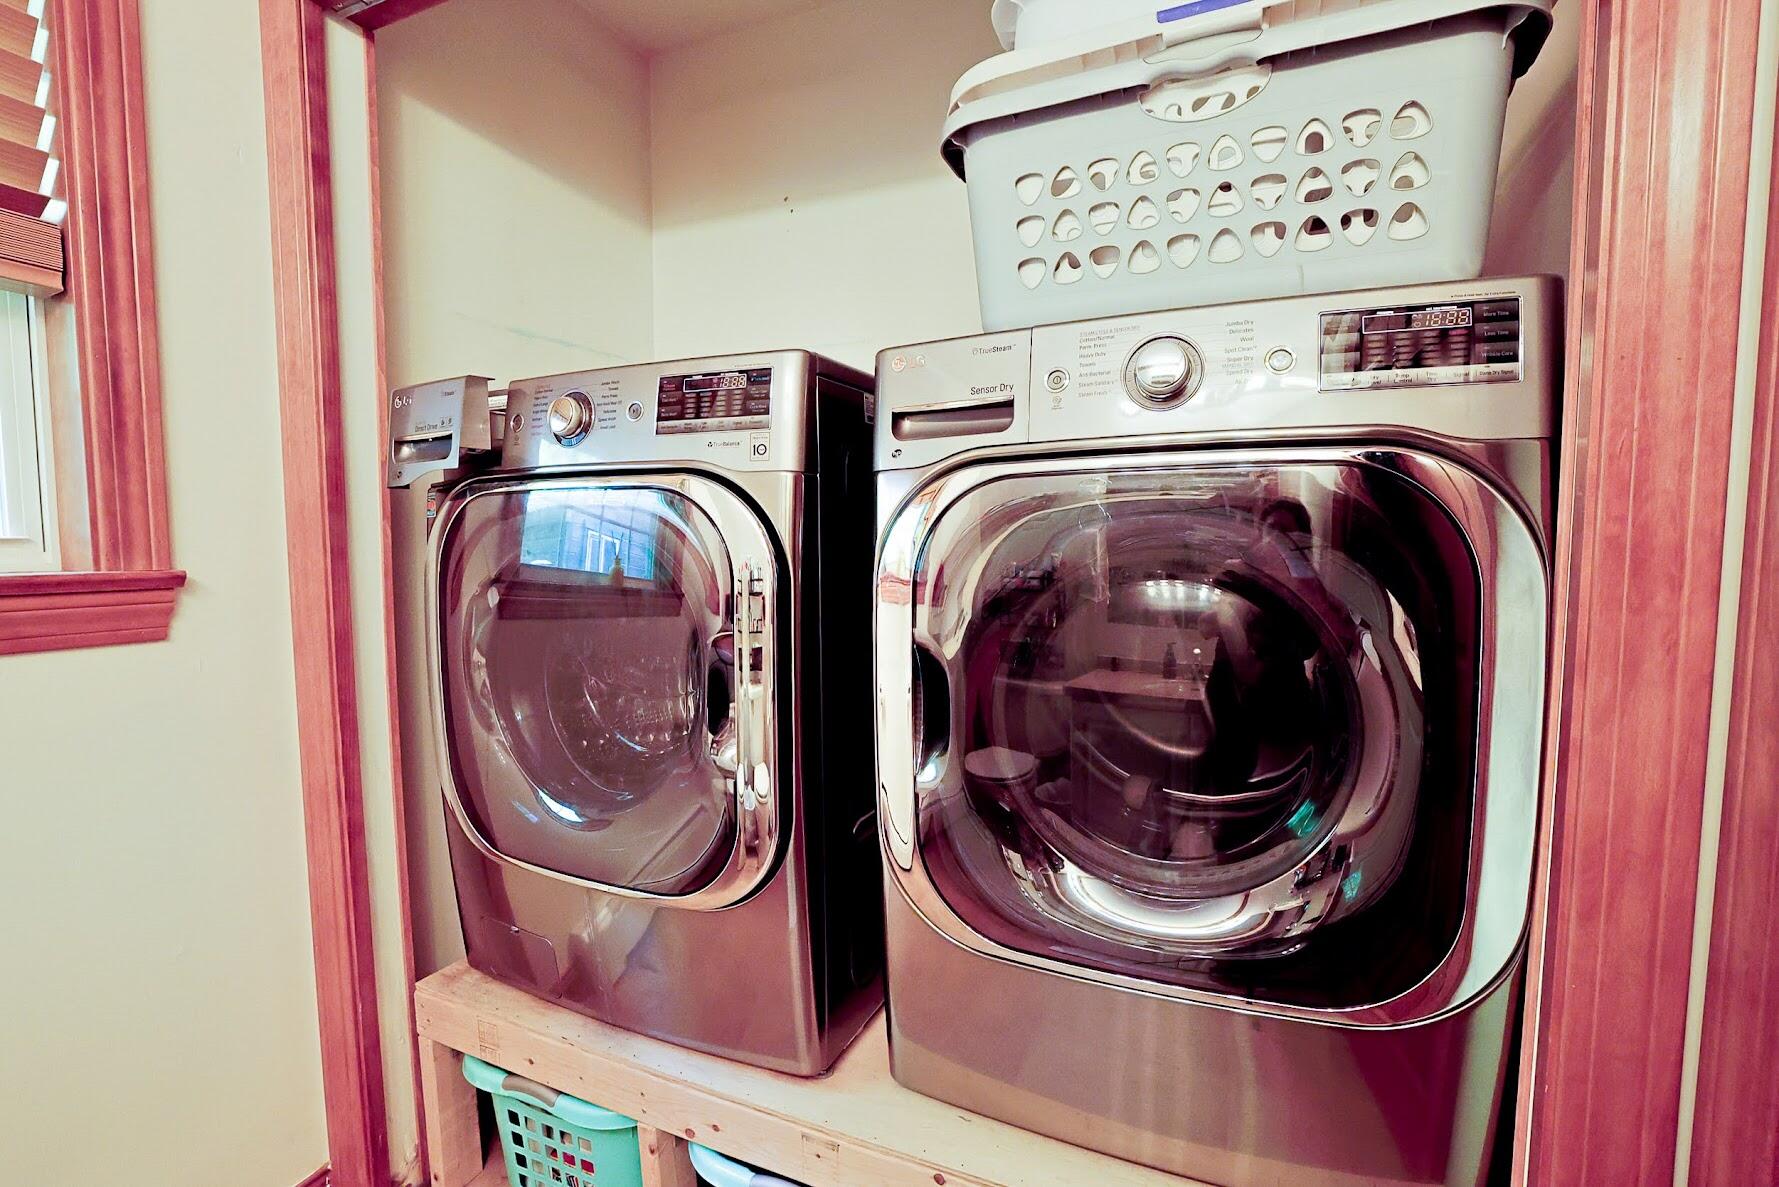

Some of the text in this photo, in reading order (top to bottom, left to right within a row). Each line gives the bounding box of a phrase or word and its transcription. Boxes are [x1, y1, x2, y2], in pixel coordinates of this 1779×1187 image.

[979, 345, 1012, 355] TrueSteam
[910, 355, 926, 368] LG
[970, 383, 1015, 396] Sensor Dry
[415, 423, 438, 433] Direct Drive
[753, 444, 767, 456] 10
